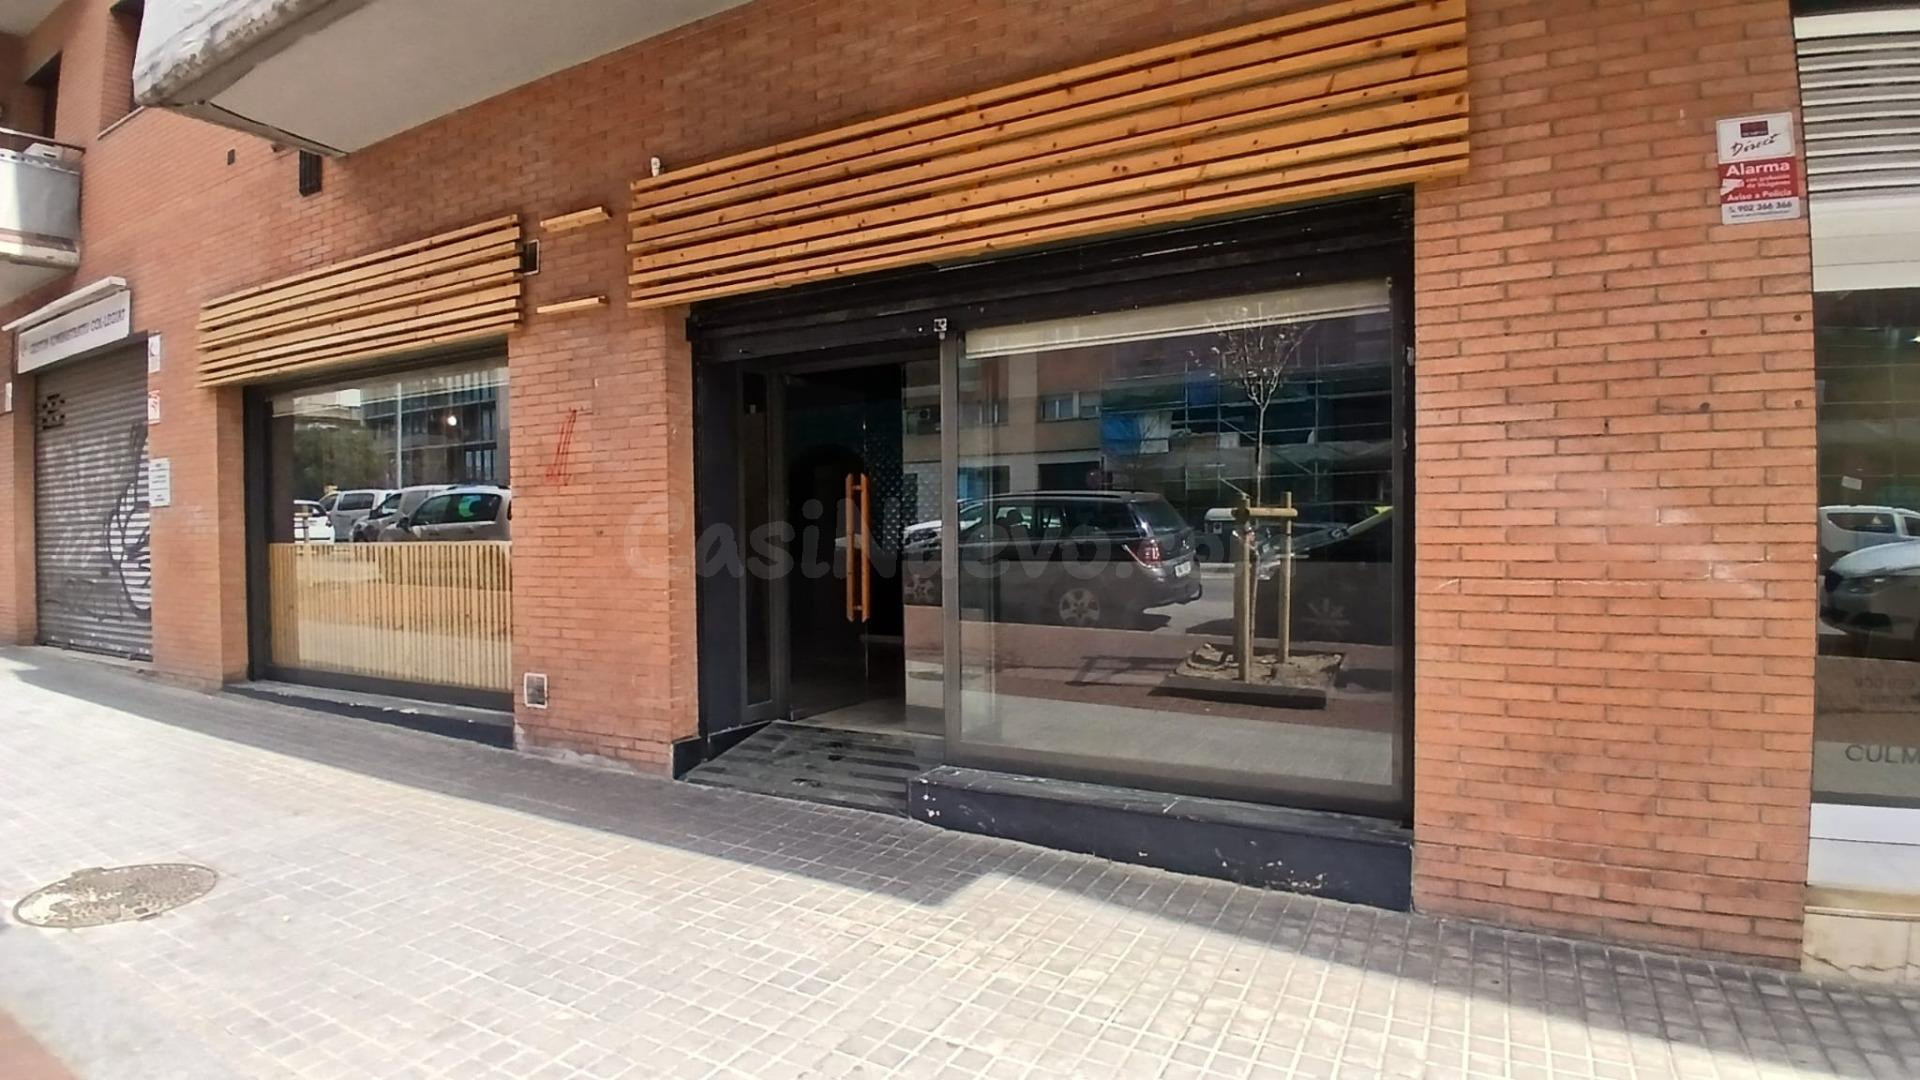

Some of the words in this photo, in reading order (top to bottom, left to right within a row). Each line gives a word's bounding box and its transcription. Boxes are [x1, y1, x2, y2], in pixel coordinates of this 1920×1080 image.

[1730, 132, 1780, 157] Direct
[1726, 161, 1790, 177] Alarma
[1727, 193, 1752, 202] Aviso
[1844, 744, 1920, 765] CULM
